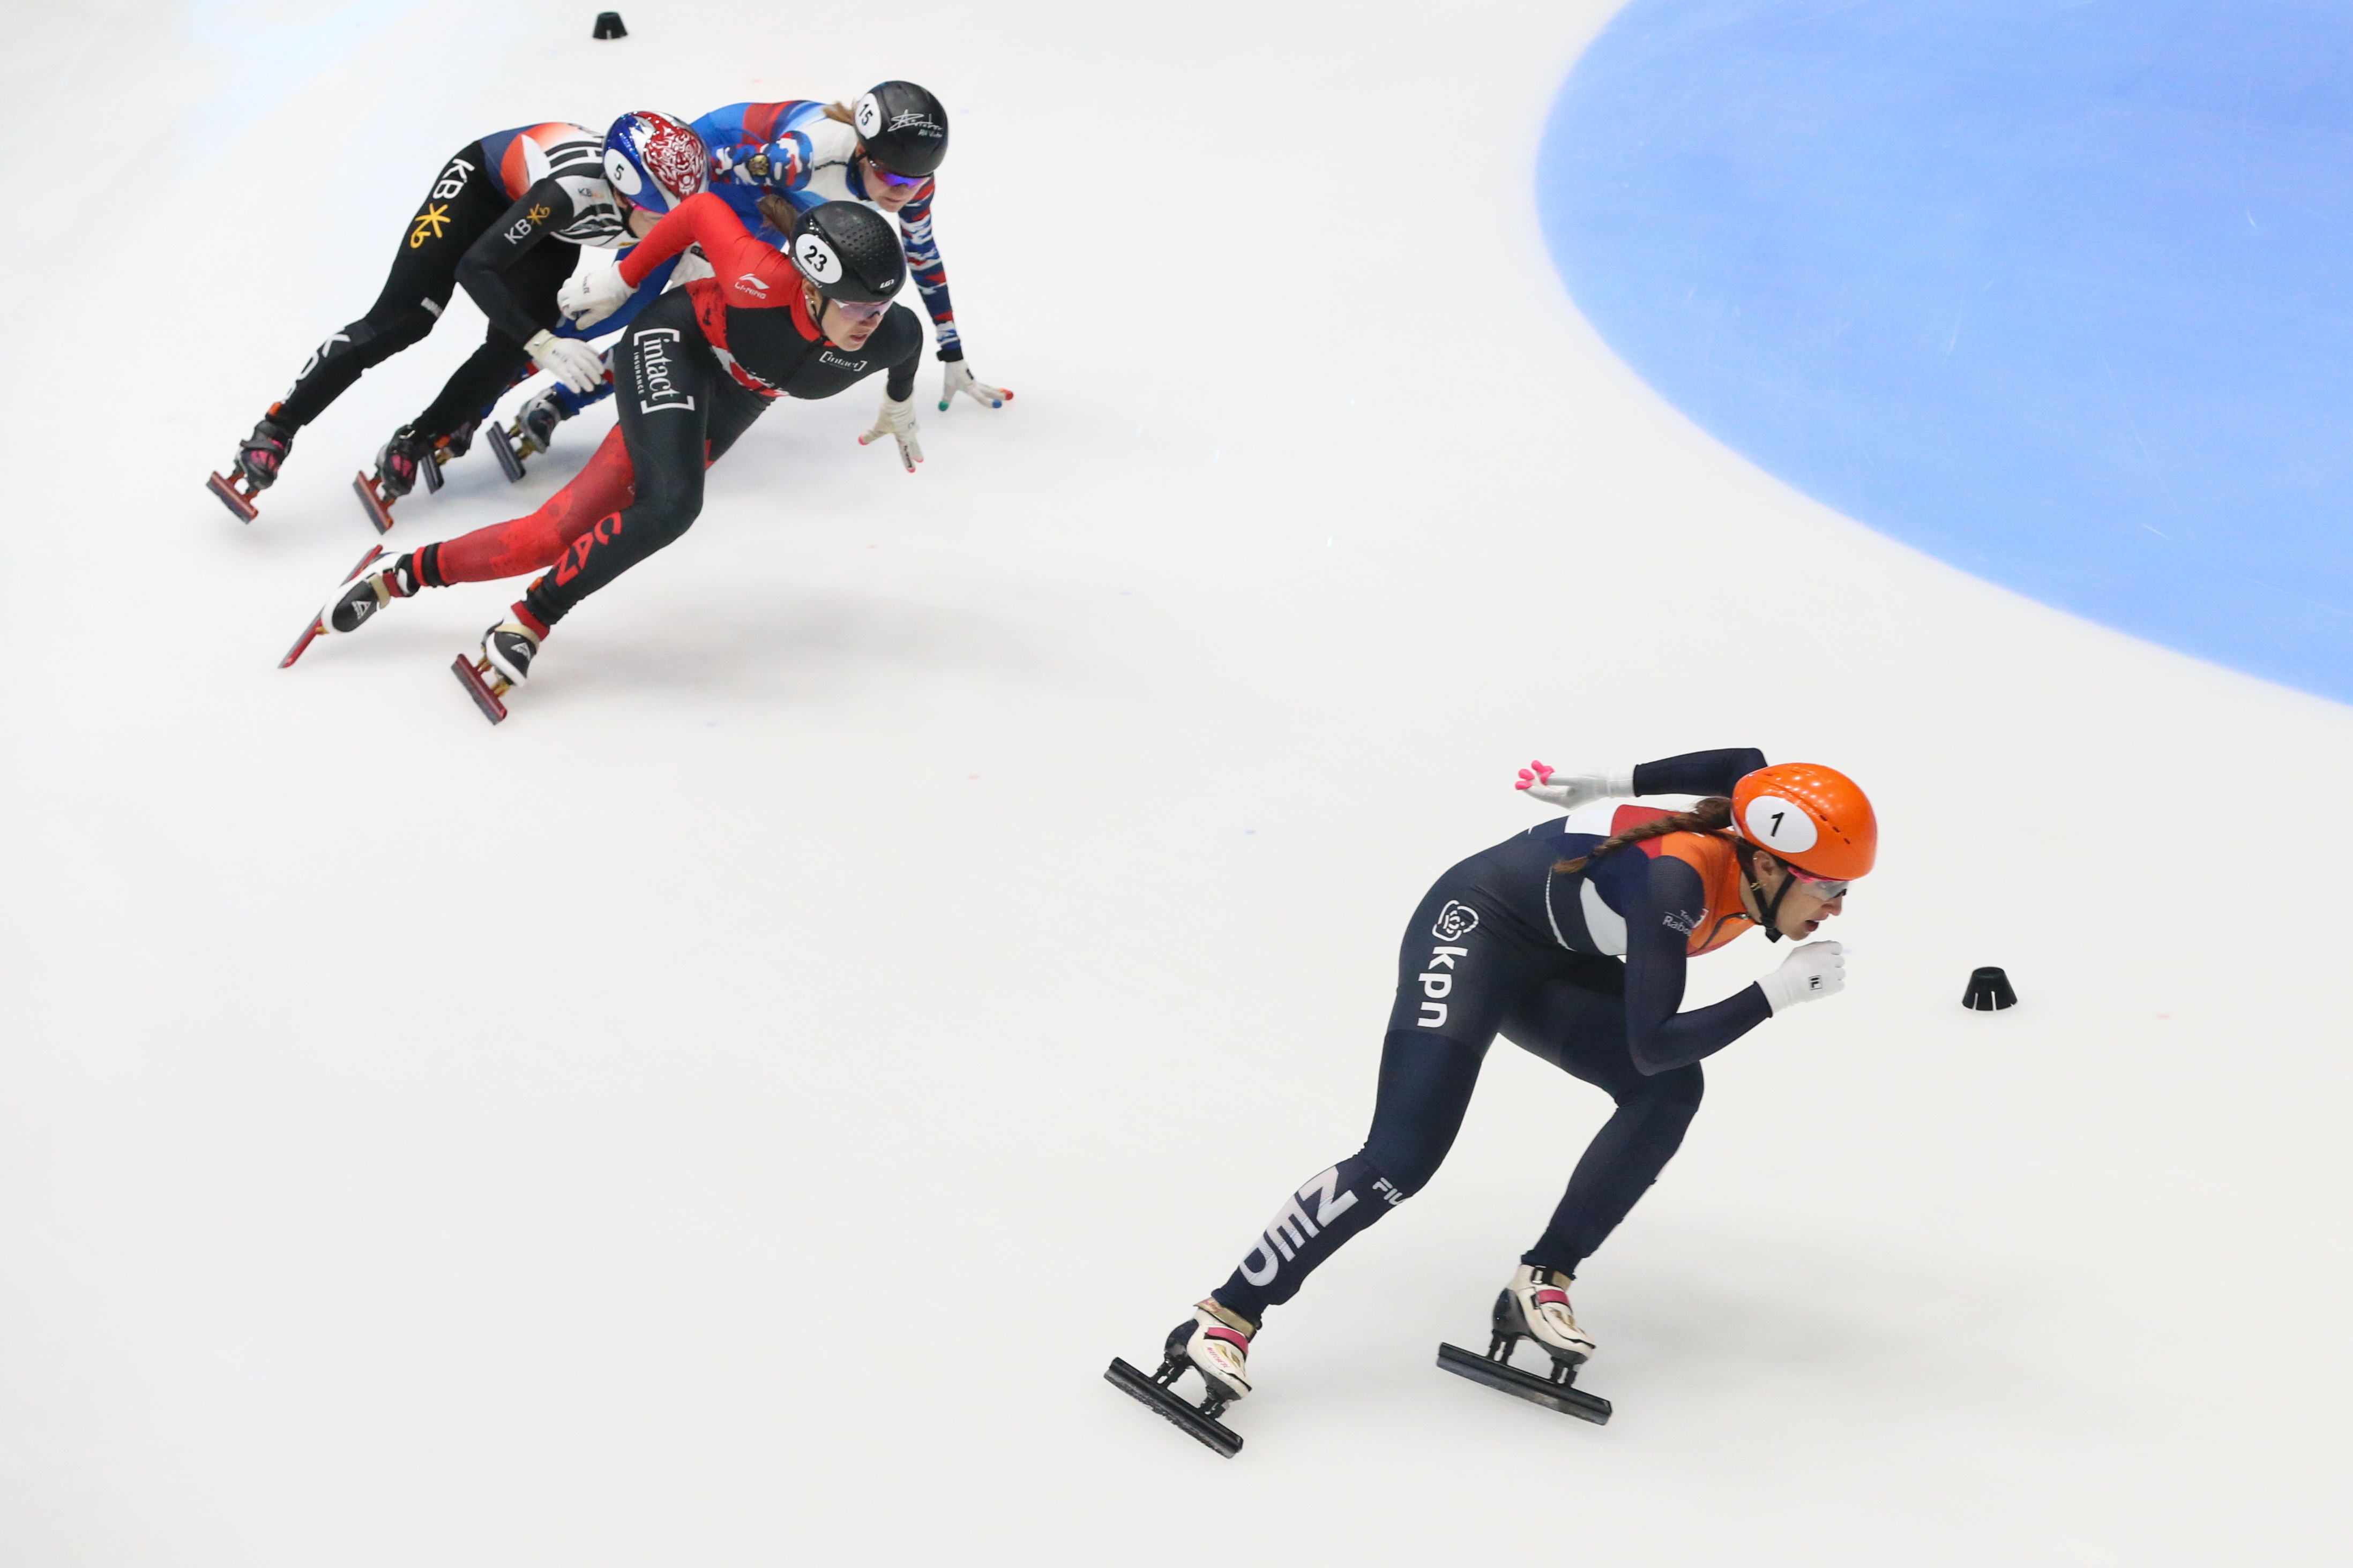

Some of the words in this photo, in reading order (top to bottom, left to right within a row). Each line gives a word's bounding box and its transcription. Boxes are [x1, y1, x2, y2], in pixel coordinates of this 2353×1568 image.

[858, 103, 873, 126] 15
[614, 164, 625, 181] 5
[804, 245, 828, 273] 23
[633, 351, 645, 395] INSURANCE
[1769, 812, 1786, 837] 1
[1416, 946, 1469, 1028] kpn
[1238, 1165, 1359, 1287] NED
